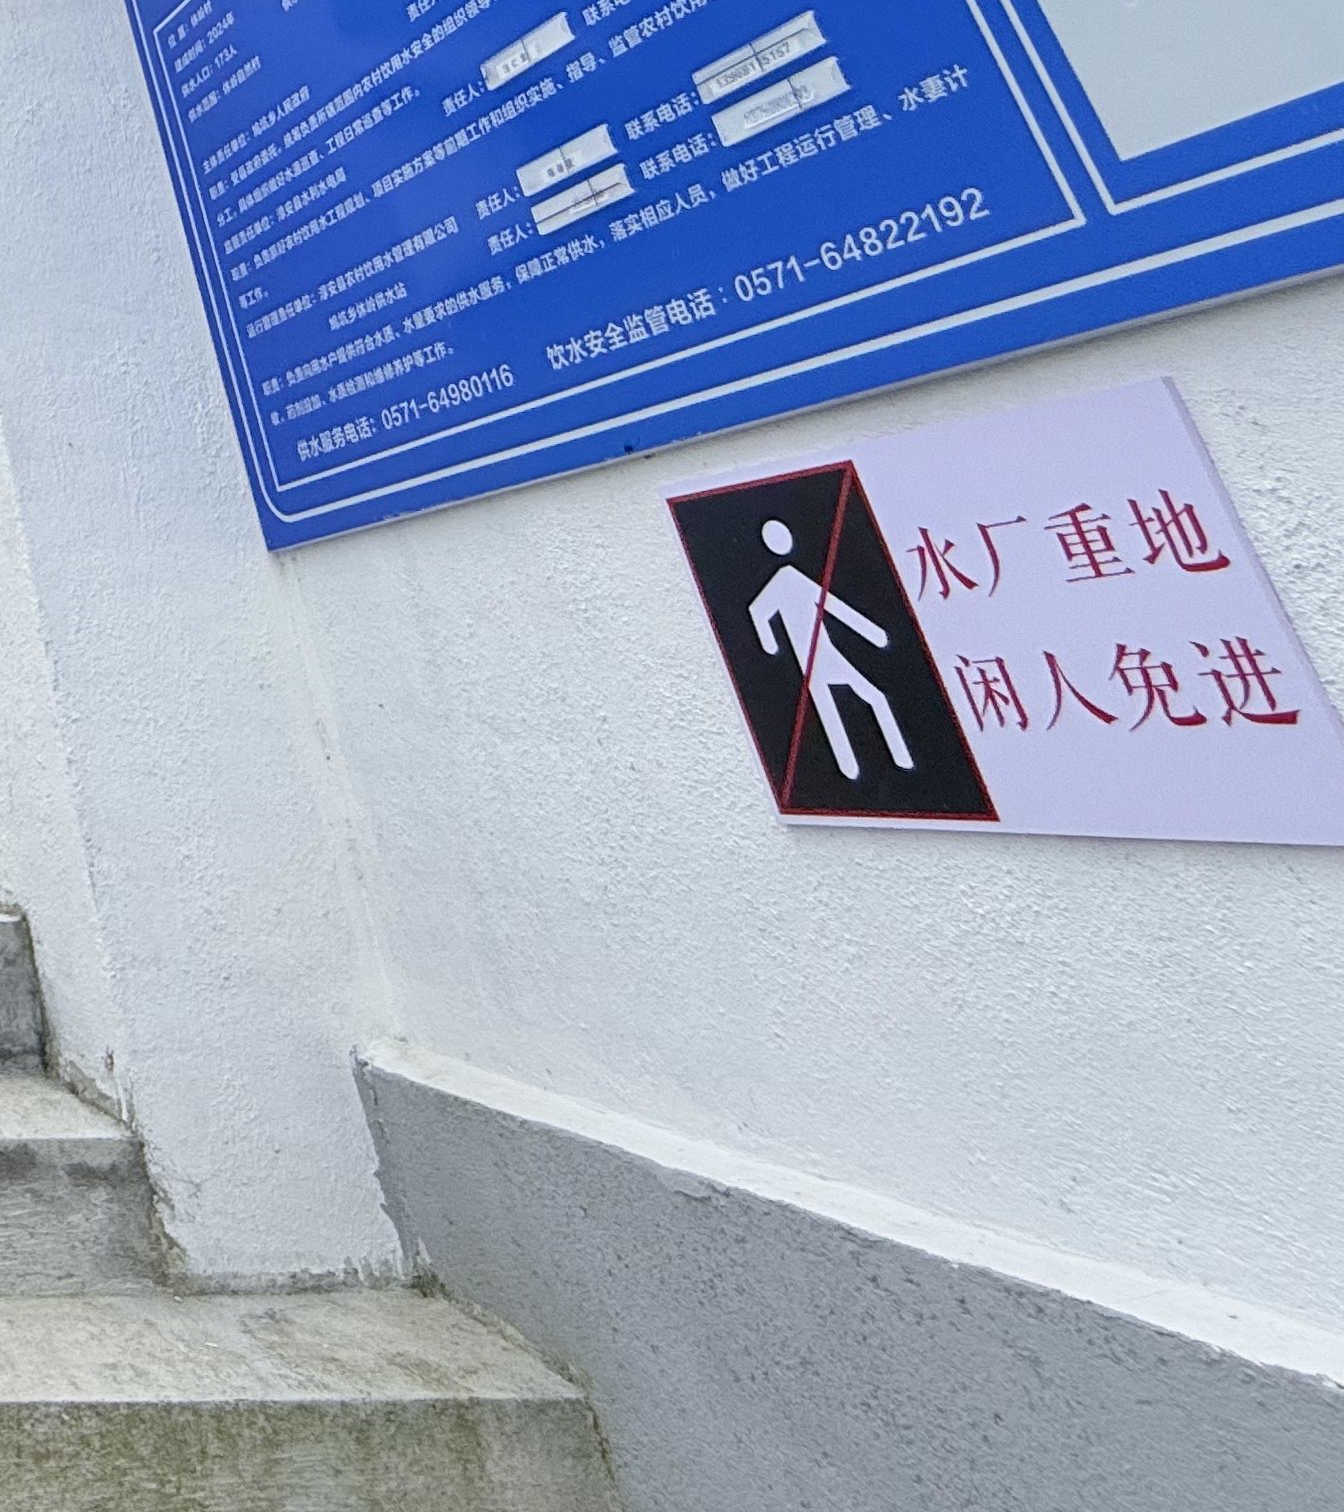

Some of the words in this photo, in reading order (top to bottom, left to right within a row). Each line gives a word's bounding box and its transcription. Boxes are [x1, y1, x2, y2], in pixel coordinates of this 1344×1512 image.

[906, 489, 1231, 601] 水厂重地
[953, 635, 1301, 733] 闲人免进
